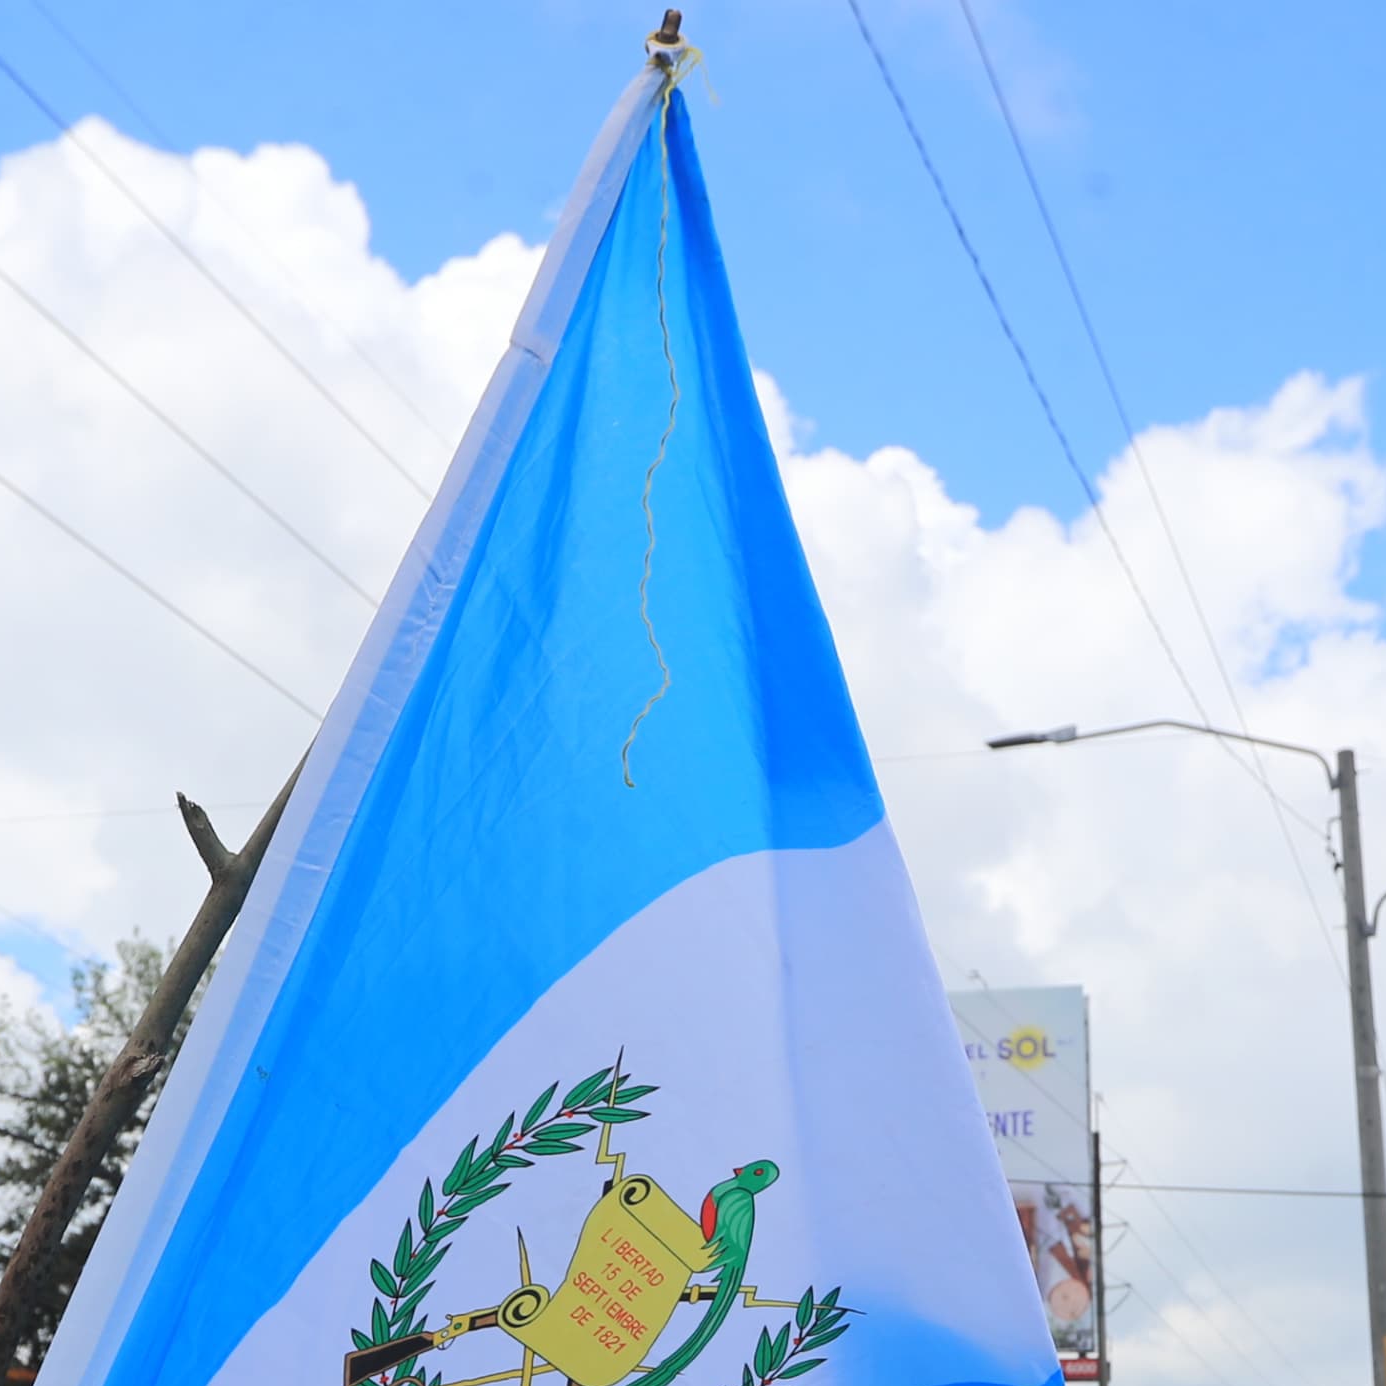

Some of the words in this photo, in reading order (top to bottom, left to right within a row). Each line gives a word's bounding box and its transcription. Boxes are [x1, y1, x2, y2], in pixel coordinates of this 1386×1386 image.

[998, 1036, 1057, 1060] SOL
[600, 1227, 664, 1287] LIBERTAD
[601, 1262, 622, 1281] 15
[619, 1278, 643, 1302] DE
[570, 1305, 595, 1327] DE
[593, 1325, 627, 1355] 1821
[573, 1271, 648, 1341] SEPTIEMBRE
